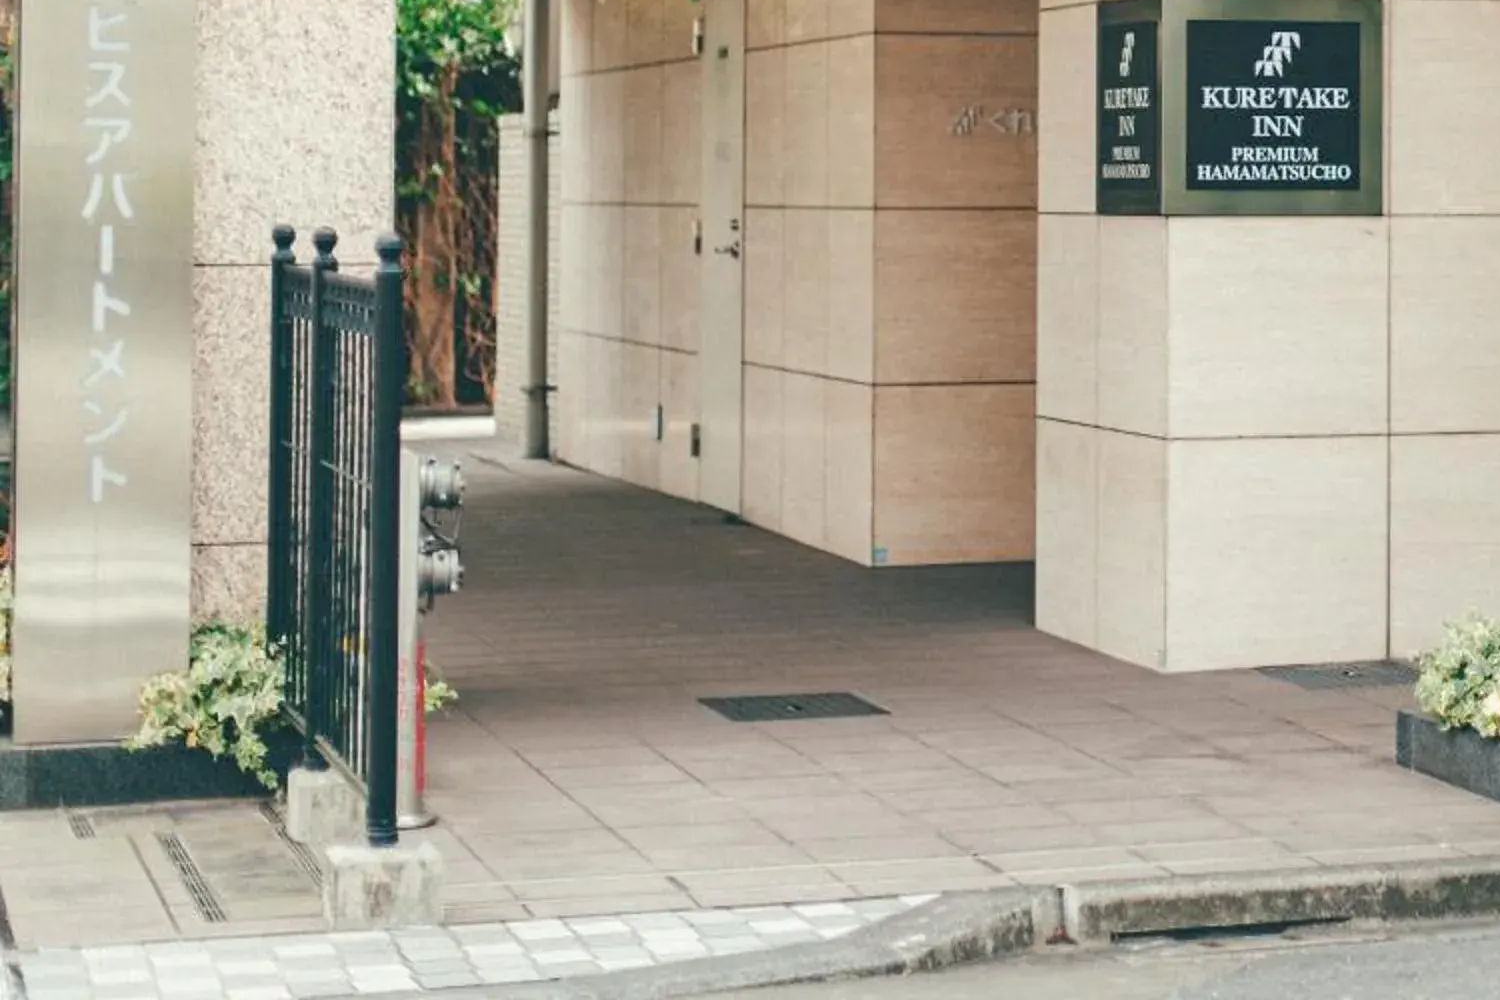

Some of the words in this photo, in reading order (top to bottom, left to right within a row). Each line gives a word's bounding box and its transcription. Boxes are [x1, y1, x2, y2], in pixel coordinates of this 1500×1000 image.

[1201, 86, 1350, 109] KURETAKE
[1252, 115, 1304, 137] INN
[1231, 146, 1318, 162] PREMIUM
[1197, 164, 1351, 181] HAMAMATSUCHO
